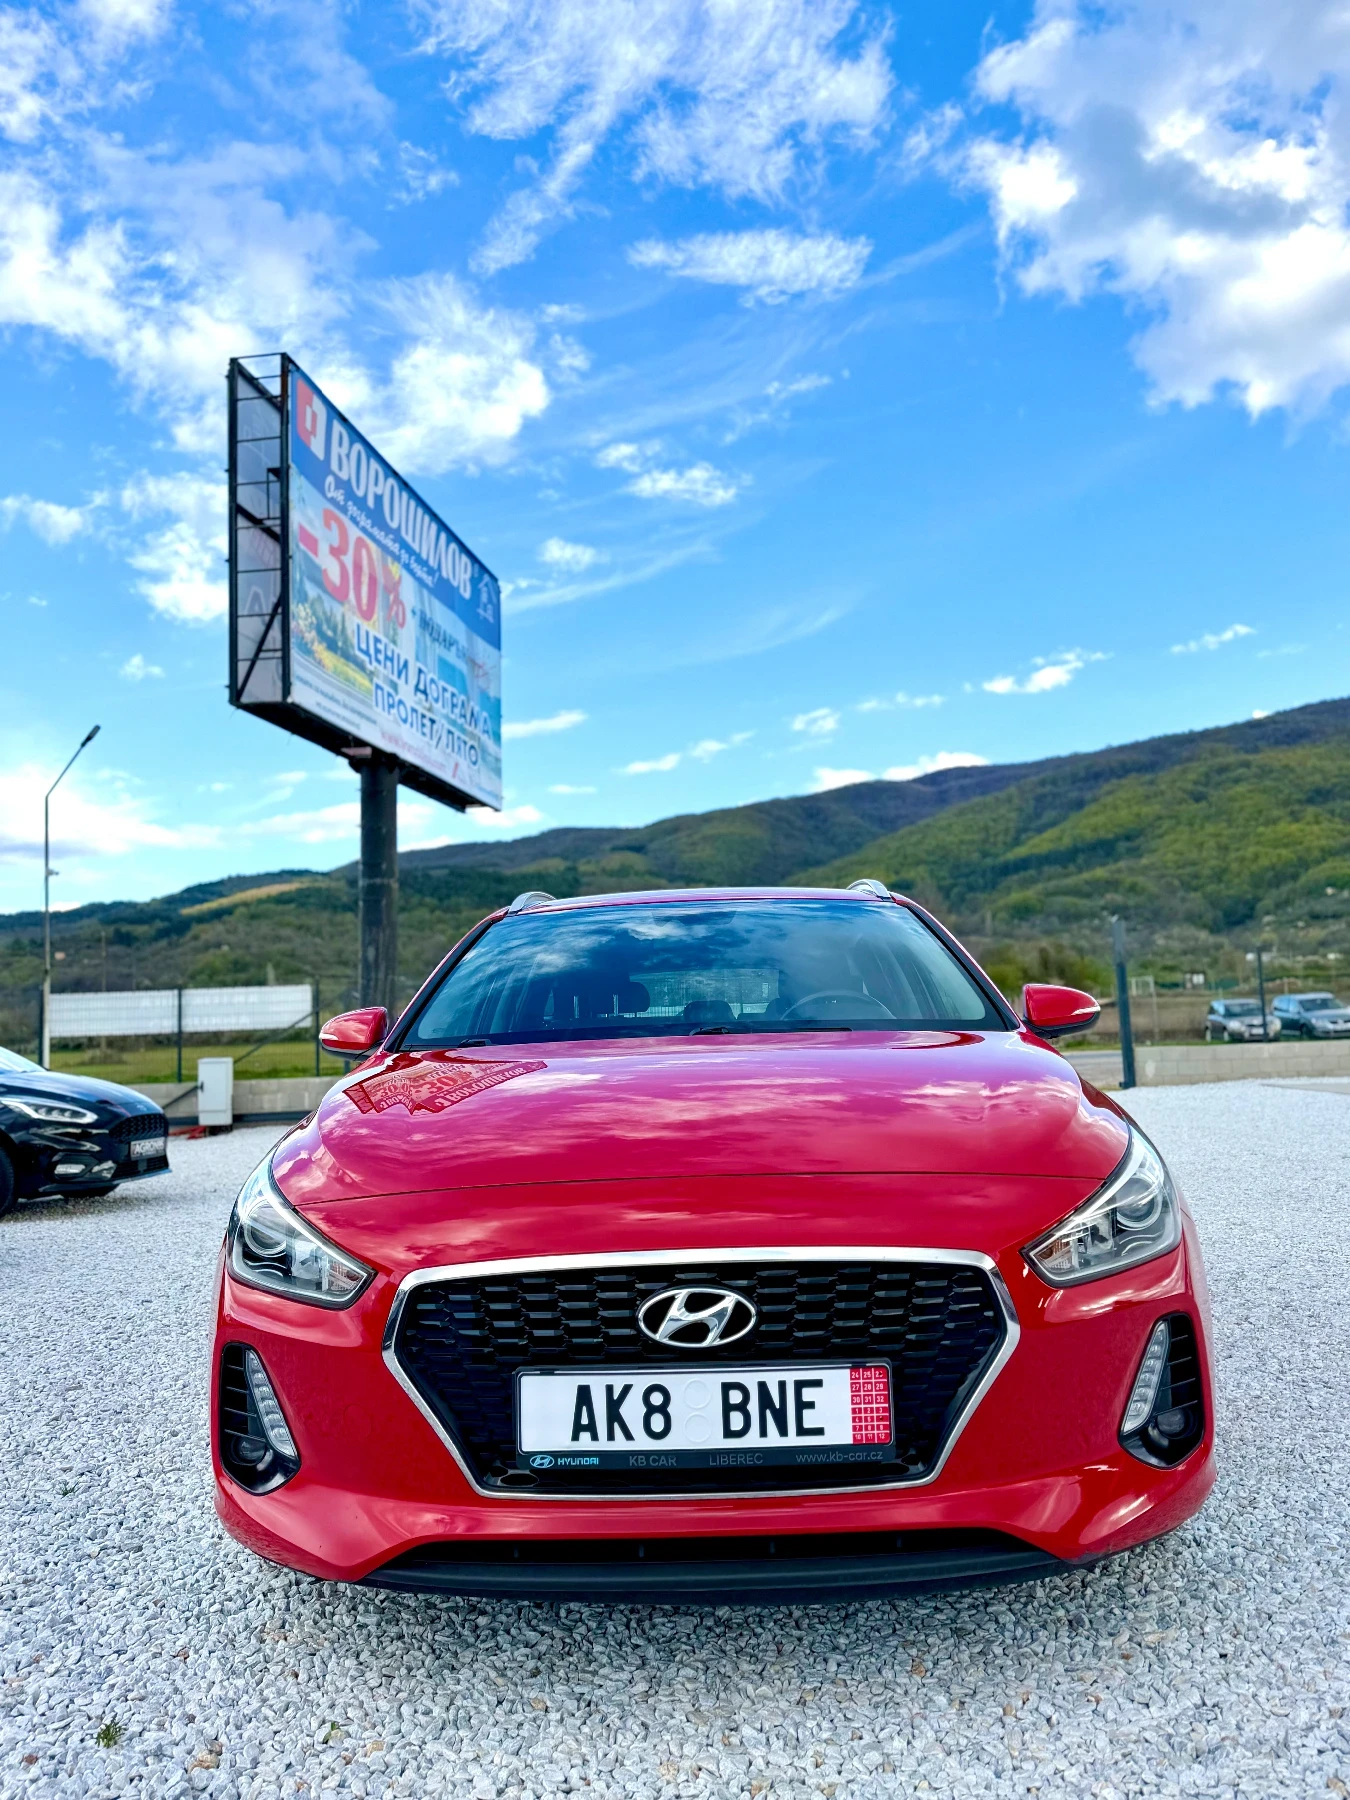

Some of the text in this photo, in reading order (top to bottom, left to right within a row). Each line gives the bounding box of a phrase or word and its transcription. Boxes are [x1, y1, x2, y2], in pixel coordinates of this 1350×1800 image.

[330, 418, 472, 600] ВОРОШИЛОВ
[356, 622, 409, 686] ЦЕНИ
[414, 665, 492, 741] ДОГРАМА
[373, 681, 479, 767] ПРОЛЕТ/ЛЯТО
[851, 1371, 859, 1379] 24
[863, 1370, 871, 1378] 25
[864, 1383, 872, 1391] 28
[571, 1379, 825, 1442] AK8 BNE
[557, 1450, 884, 1467] HYUNDAI KB CAR LIBEREC www.kb-car.cz
